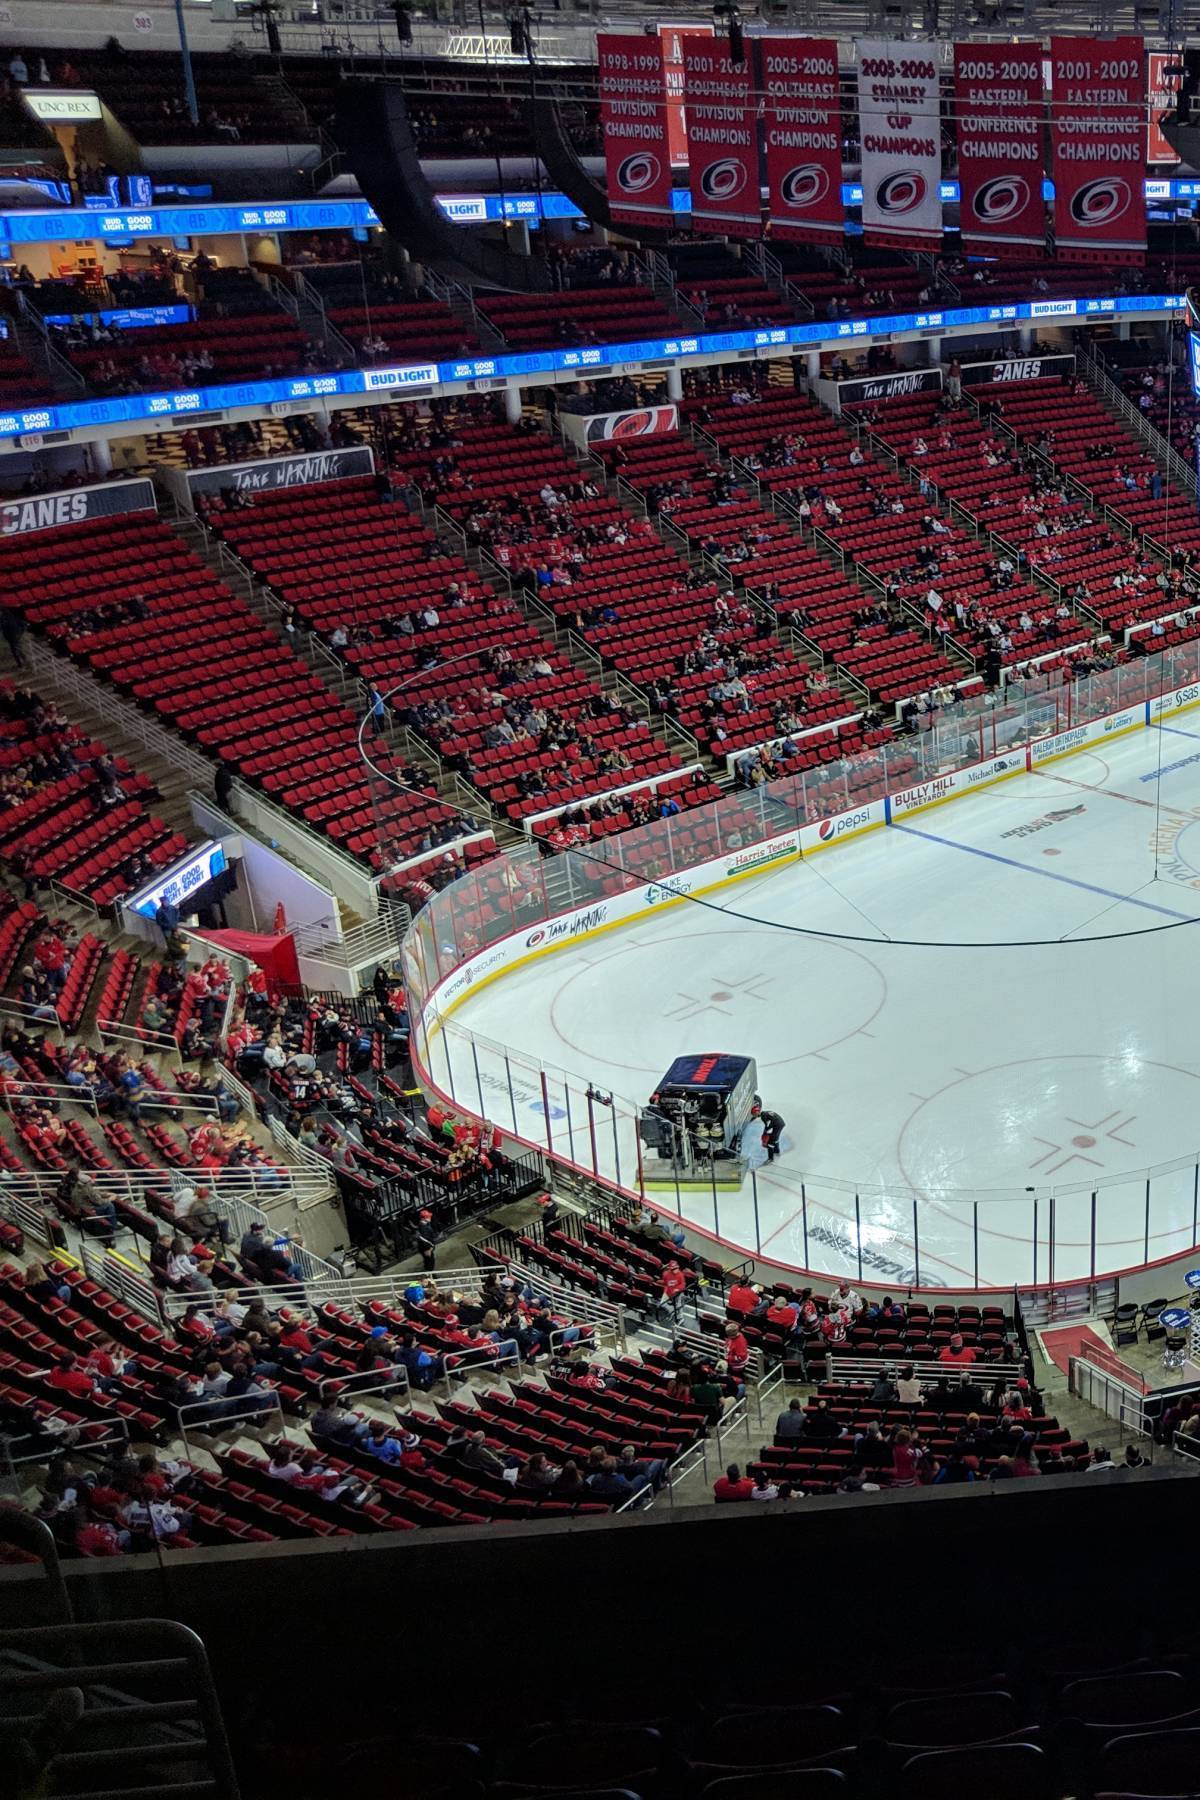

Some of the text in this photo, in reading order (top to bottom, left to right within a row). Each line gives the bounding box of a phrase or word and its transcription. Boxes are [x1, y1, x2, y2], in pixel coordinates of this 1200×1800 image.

[601, 54, 661, 72] 1998-1999
[767, 56, 834, 76] 2005-2006
[862, 59, 935, 80] 2005-2006
[959, 62, 1038, 80] 2005-2006
[1057, 60, 1139, 80] 2001-2002
[603, 77, 662, 94] SOUTHEAST
[687, 80, 749, 98] SOUTHEAST
[768, 81, 835, 100] SOUTHEAST
[969, 88, 1028, 107] EASTERN
[1067, 88, 1128, 106] EASTERN
[37, 101, 92, 114] UNC REX
[610, 100, 657, 117] DIVISION
[696, 105, 744, 122] DIVISION
[776, 109, 828, 125] DIVISION
[887, 111, 912, 130] CUP
[961, 116, 1038, 134] CONFERENCE
[1057, 115, 1140, 134] CONFERENCE
[605, 121, 664, 140] CHAMPIONS
[690, 126, 751, 145] CHAMPIONS
[769, 130, 838, 150] CHAMPIONS
[864, 135, 936, 157] CHAMPIONS
[962, 140, 1039, 160] CHAMPIONS
[1057, 142, 1140, 161] CHAMPIONS
[450, 204, 480, 214] LIGHT
[1034, 302, 1073, 314] BUD LIGHT
[370, 369, 433, 386] BUD LIGHT
[992, 361, 1041, 382] CANES
[313, 379, 337, 387] GOOD
[315, 385, 337, 394] SPORT
[862, 373, 924, 399] TAKE WARNING
[150, 403, 172, 412] LIGHT
[151, 398, 168, 406] BUD
[174, 394, 200, 403] GOOD
[175, 401, 201, 411] SPORT
[22, 412, 50, 423] GOOD
[24, 420, 50, 430] SPORT
[232, 455, 343, 491] TAKE WARNING
[2, 493, 88, 533] CANES
[1113, 716, 1133, 729] Lottery
[1033, 740, 1055, 756] RALEIGH
[967, 766, 995, 784] Michael
[894, 776, 956, 807] BULLY HILL
[905, 790, 946, 810] VINEYARDS
[836, 807, 870, 835] pepsi
[735, 838, 796, 866] Harris Teeter
[1148, 816, 1198, 883] PNC ARENA
[181, 864, 201, 885] GOOD
[183, 869, 205, 892] SPORT
[162, 880, 179, 897] BUD
[660, 876, 682, 892] DUKE
[661, 882, 692, 901] ENERGY
[546, 905, 607, 939] TAKE WARNING
[472, 950, 506, 975] SECURITY
[295, 1086, 307, 1099] 14
